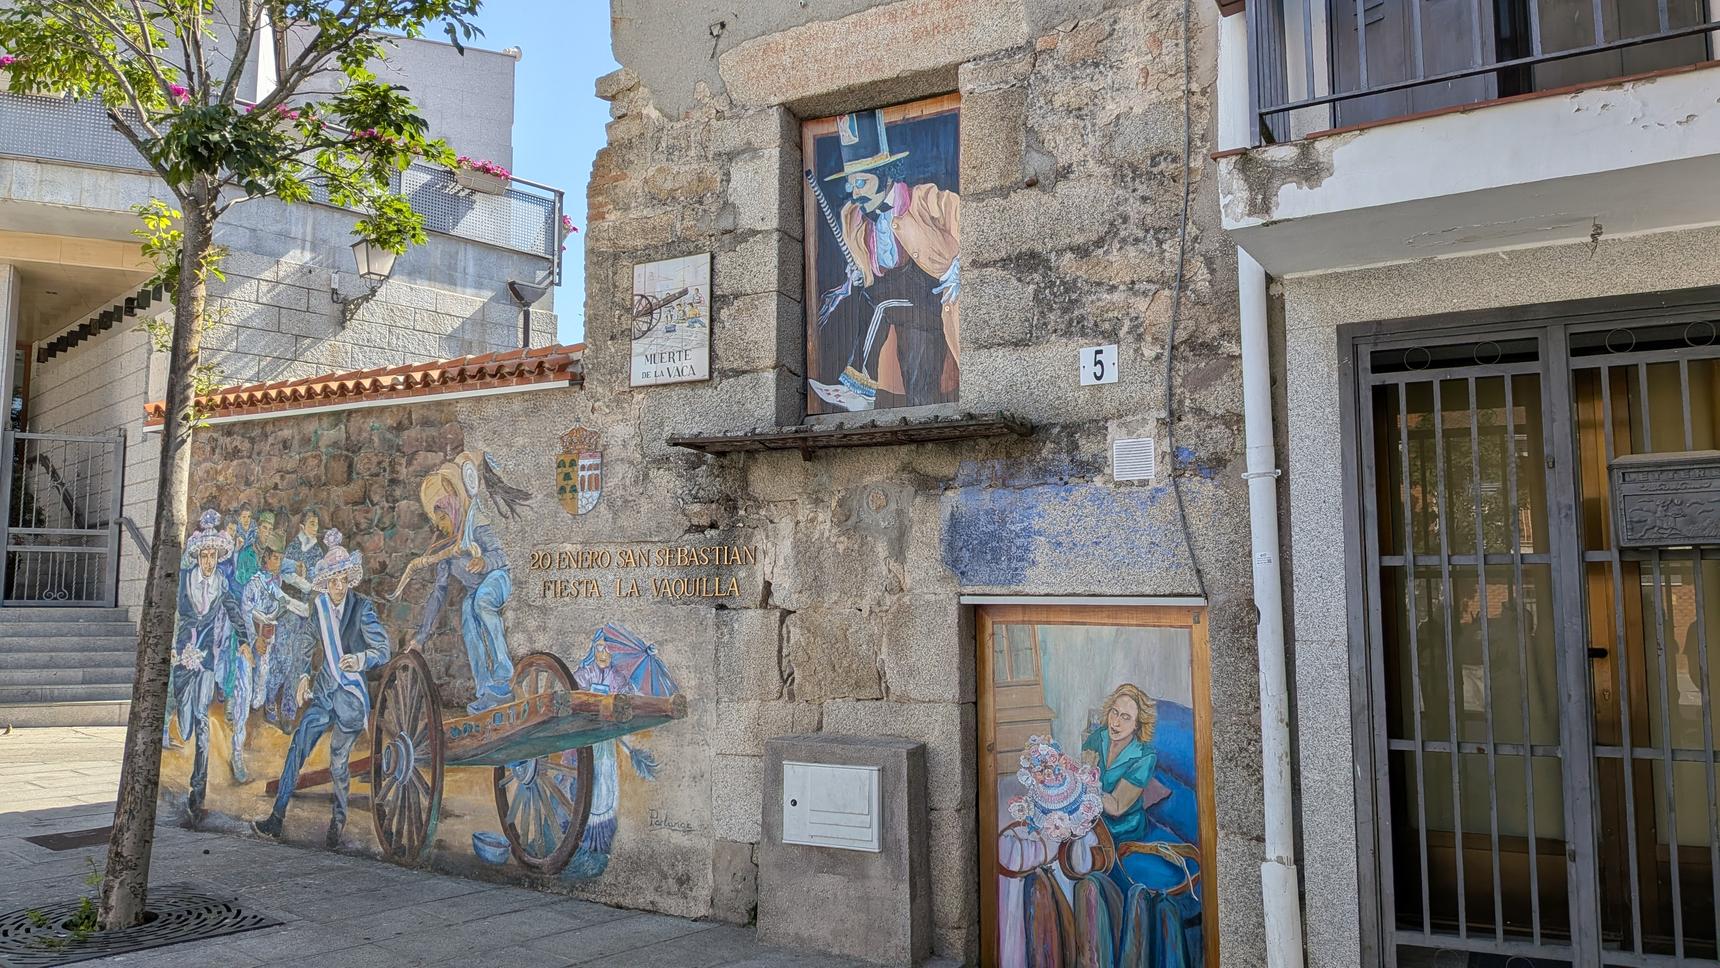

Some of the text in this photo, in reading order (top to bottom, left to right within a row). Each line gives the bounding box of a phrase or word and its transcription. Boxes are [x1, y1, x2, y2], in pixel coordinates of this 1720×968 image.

[645, 349, 692, 365] MUERTE
[1093, 349, 1105, 381] 5
[641, 371, 651, 379] DE
[654, 370, 665, 378] LA
[666, 364, 696, 378] VACA
[530, 545, 757, 570] 20 ENERO SAN SEBASTIAN
[542, 576, 741, 599] FIESTA LA VAQUILLA
